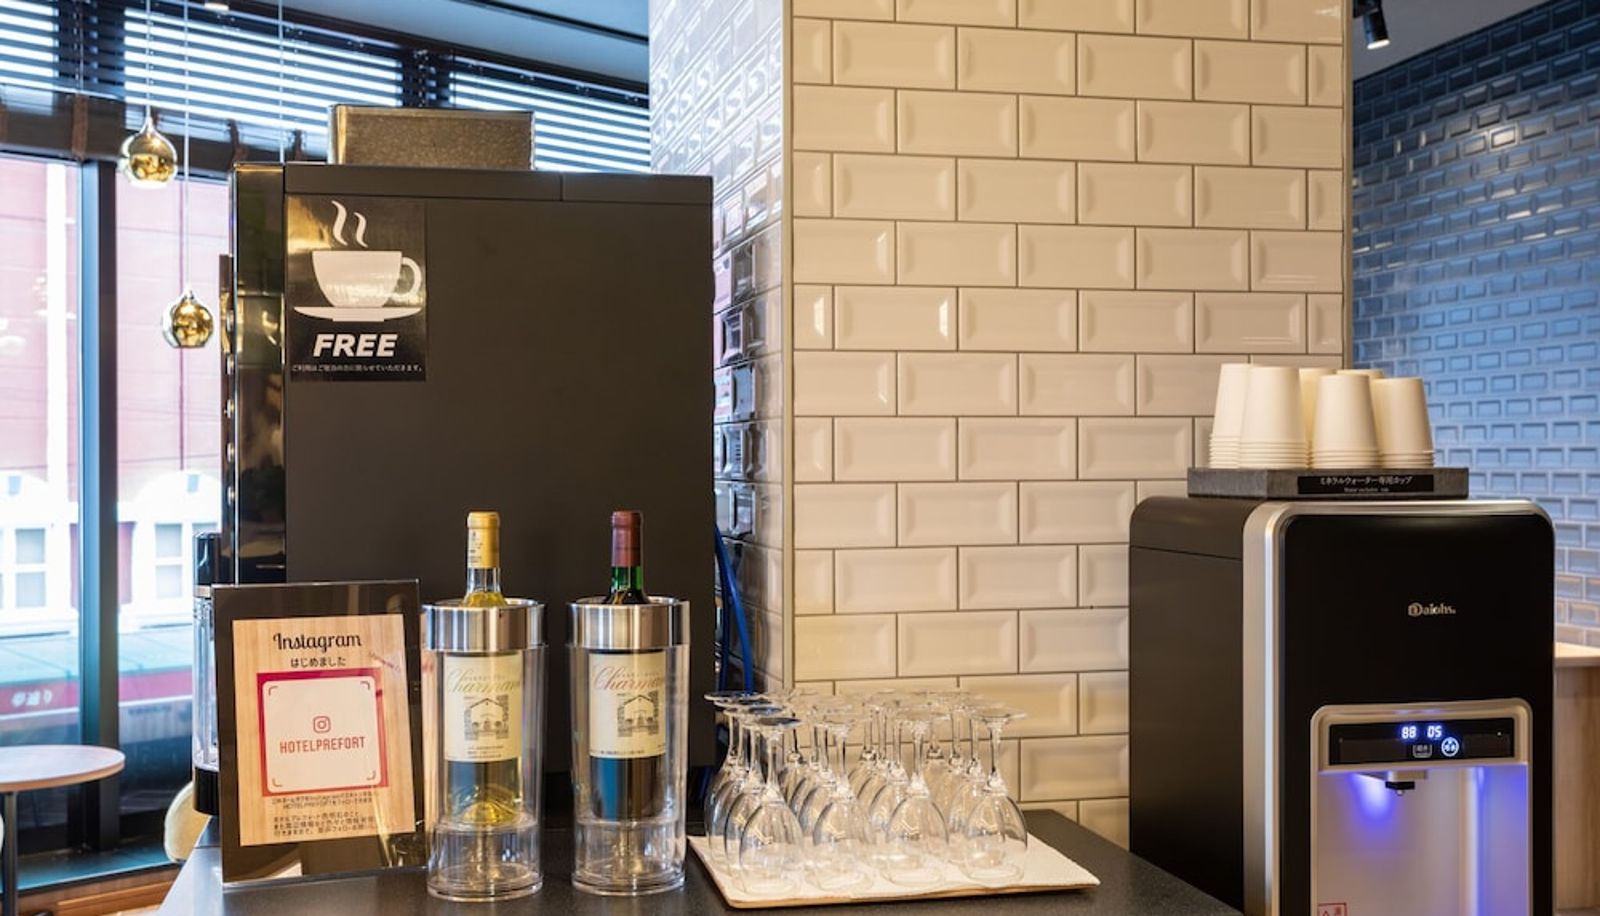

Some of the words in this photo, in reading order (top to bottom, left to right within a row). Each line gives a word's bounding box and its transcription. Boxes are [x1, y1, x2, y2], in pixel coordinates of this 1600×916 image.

[313, 334, 398, 357] FREE
[273, 632, 362, 653] Instagram
[290, 656, 347, 669] はじめました
[279, 736, 366, 754] HOTELPREFORT
